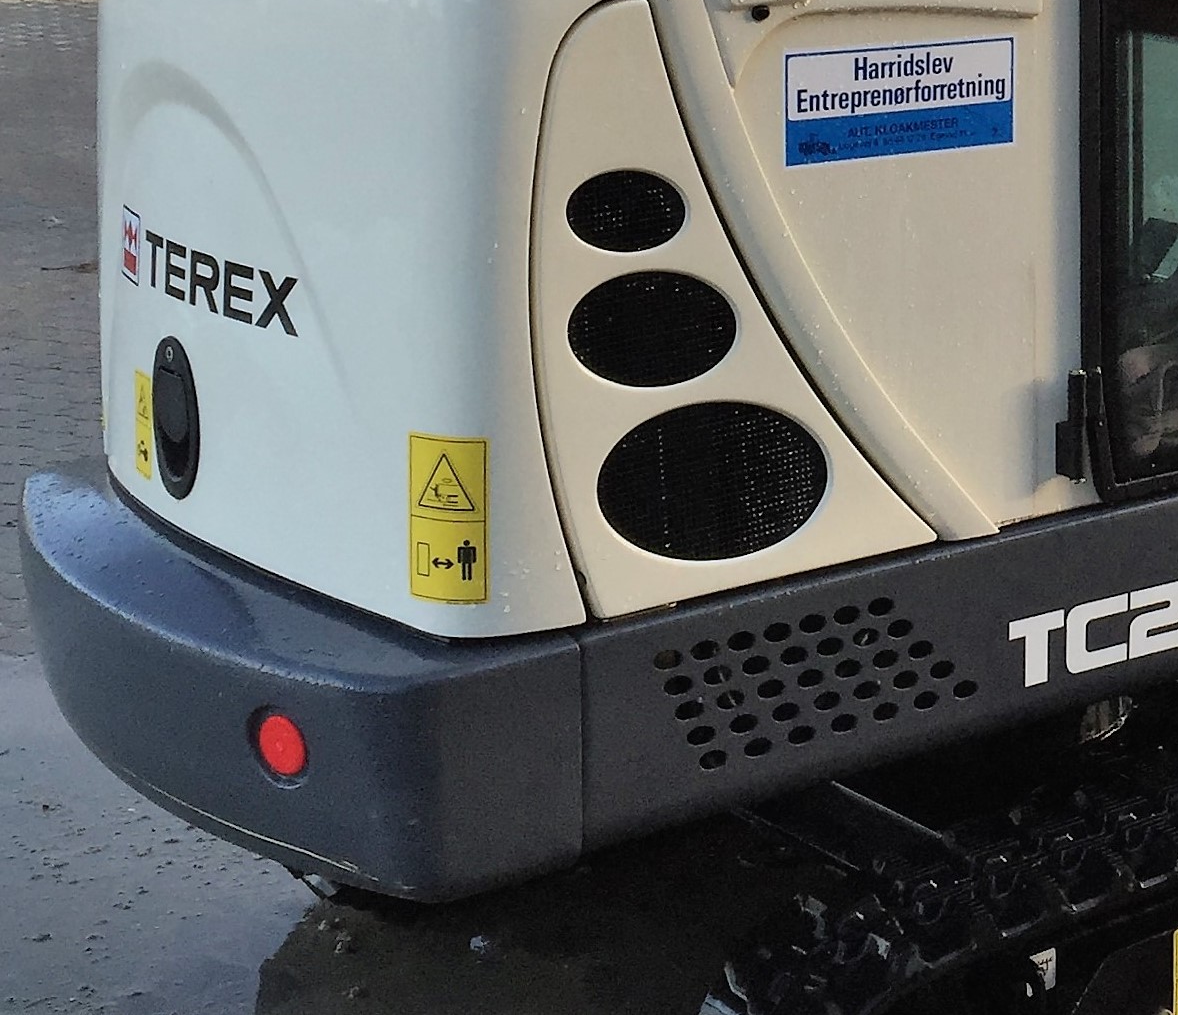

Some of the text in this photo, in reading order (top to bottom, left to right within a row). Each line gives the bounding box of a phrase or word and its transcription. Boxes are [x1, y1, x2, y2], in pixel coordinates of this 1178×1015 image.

[853, 51, 954, 81] Harridslev
[796, 73, 1007, 114] Entreprenørforretning
[874, 117, 959, 136] KLOAKMESTER
[145, 229, 299, 338] TEREX
